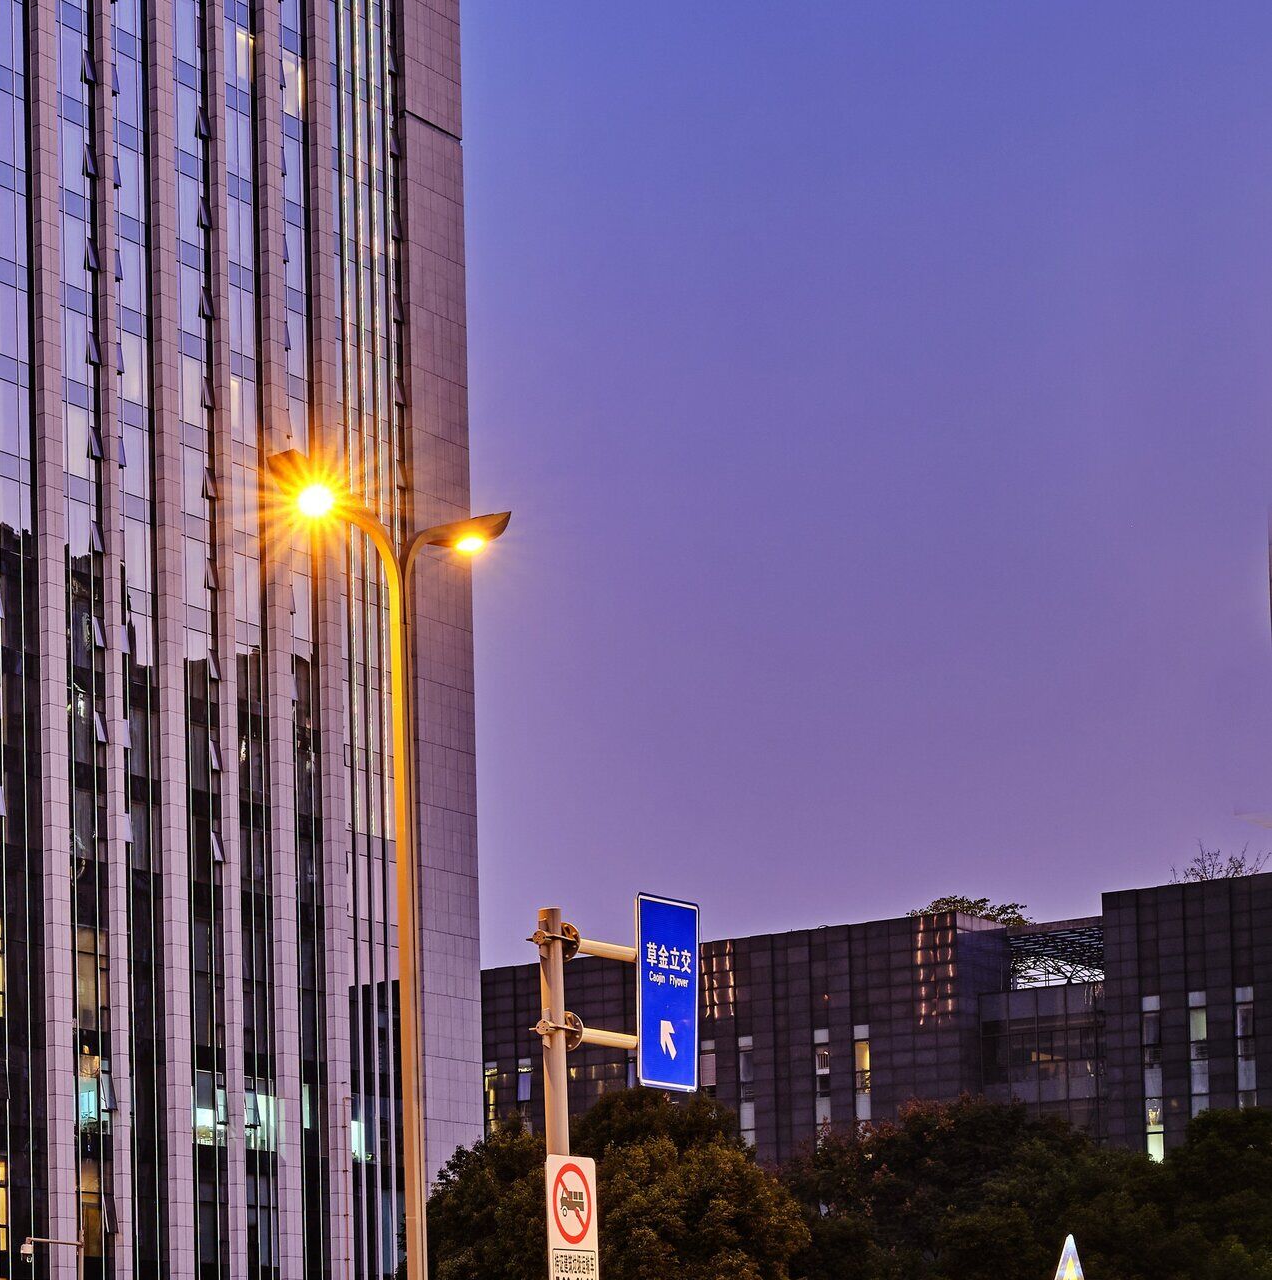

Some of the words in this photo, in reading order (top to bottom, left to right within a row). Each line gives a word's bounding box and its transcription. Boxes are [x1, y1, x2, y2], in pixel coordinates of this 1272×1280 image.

[646, 941, 692, 974] 草金立交
[648, 970, 666, 986] Caojin
[669, 974, 689, 988] Flyover
